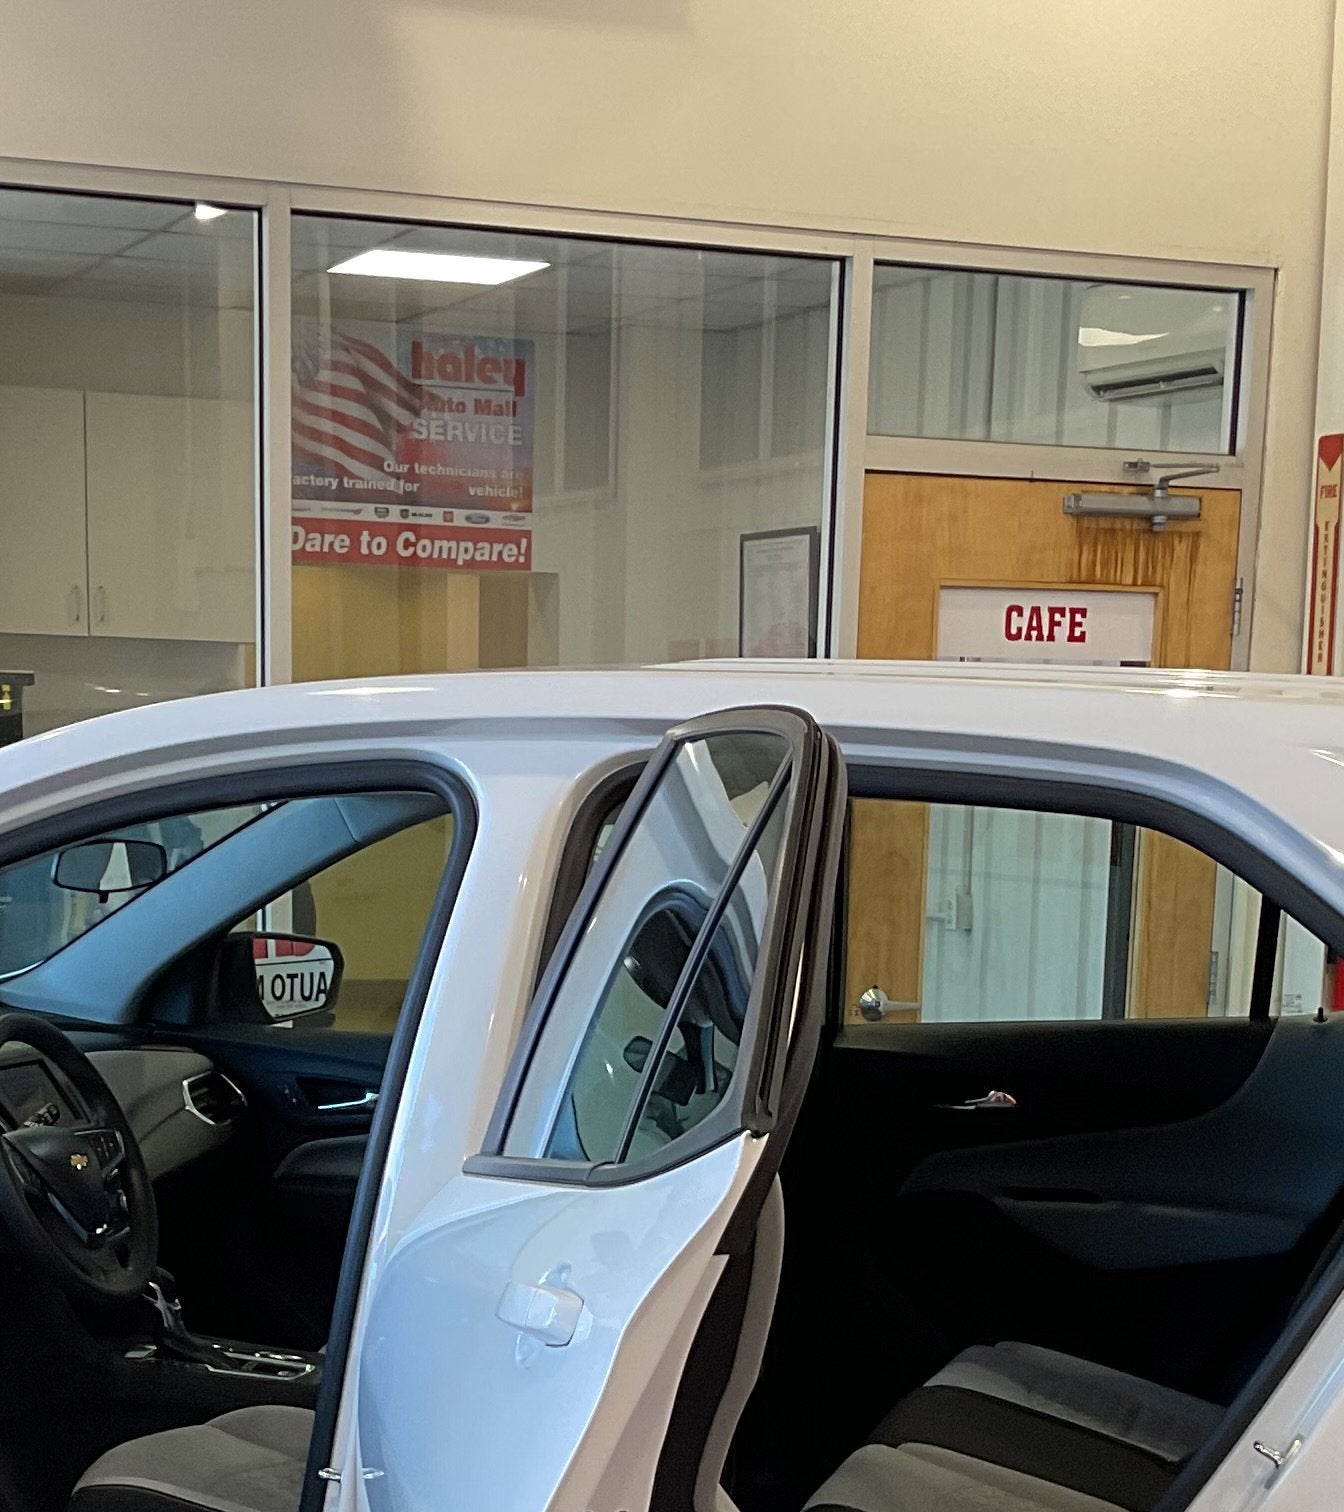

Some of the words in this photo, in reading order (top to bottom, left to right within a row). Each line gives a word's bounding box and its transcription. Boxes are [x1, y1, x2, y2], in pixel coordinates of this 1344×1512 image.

[411, 339, 527, 398] haley
[474, 399, 517, 417] Mall
[411, 418, 523, 446] SERVICE
[383, 460, 410, 473] Our
[415, 462, 497, 479] technicians
[292, 475, 338, 490] actory
[344, 476, 395, 491] trained
[398, 478, 420, 494] for
[468, 483, 524, 499] vehicle!
[1319, 484, 1338, 499] FIRE
[291, 525, 351, 553] Dare
[359, 530, 388, 555] to
[396, 531, 528, 565] Compare!
[1317, 520, 1330, 663] EXTINGUISHER
[1004, 604, 1088, 643] CAFE
